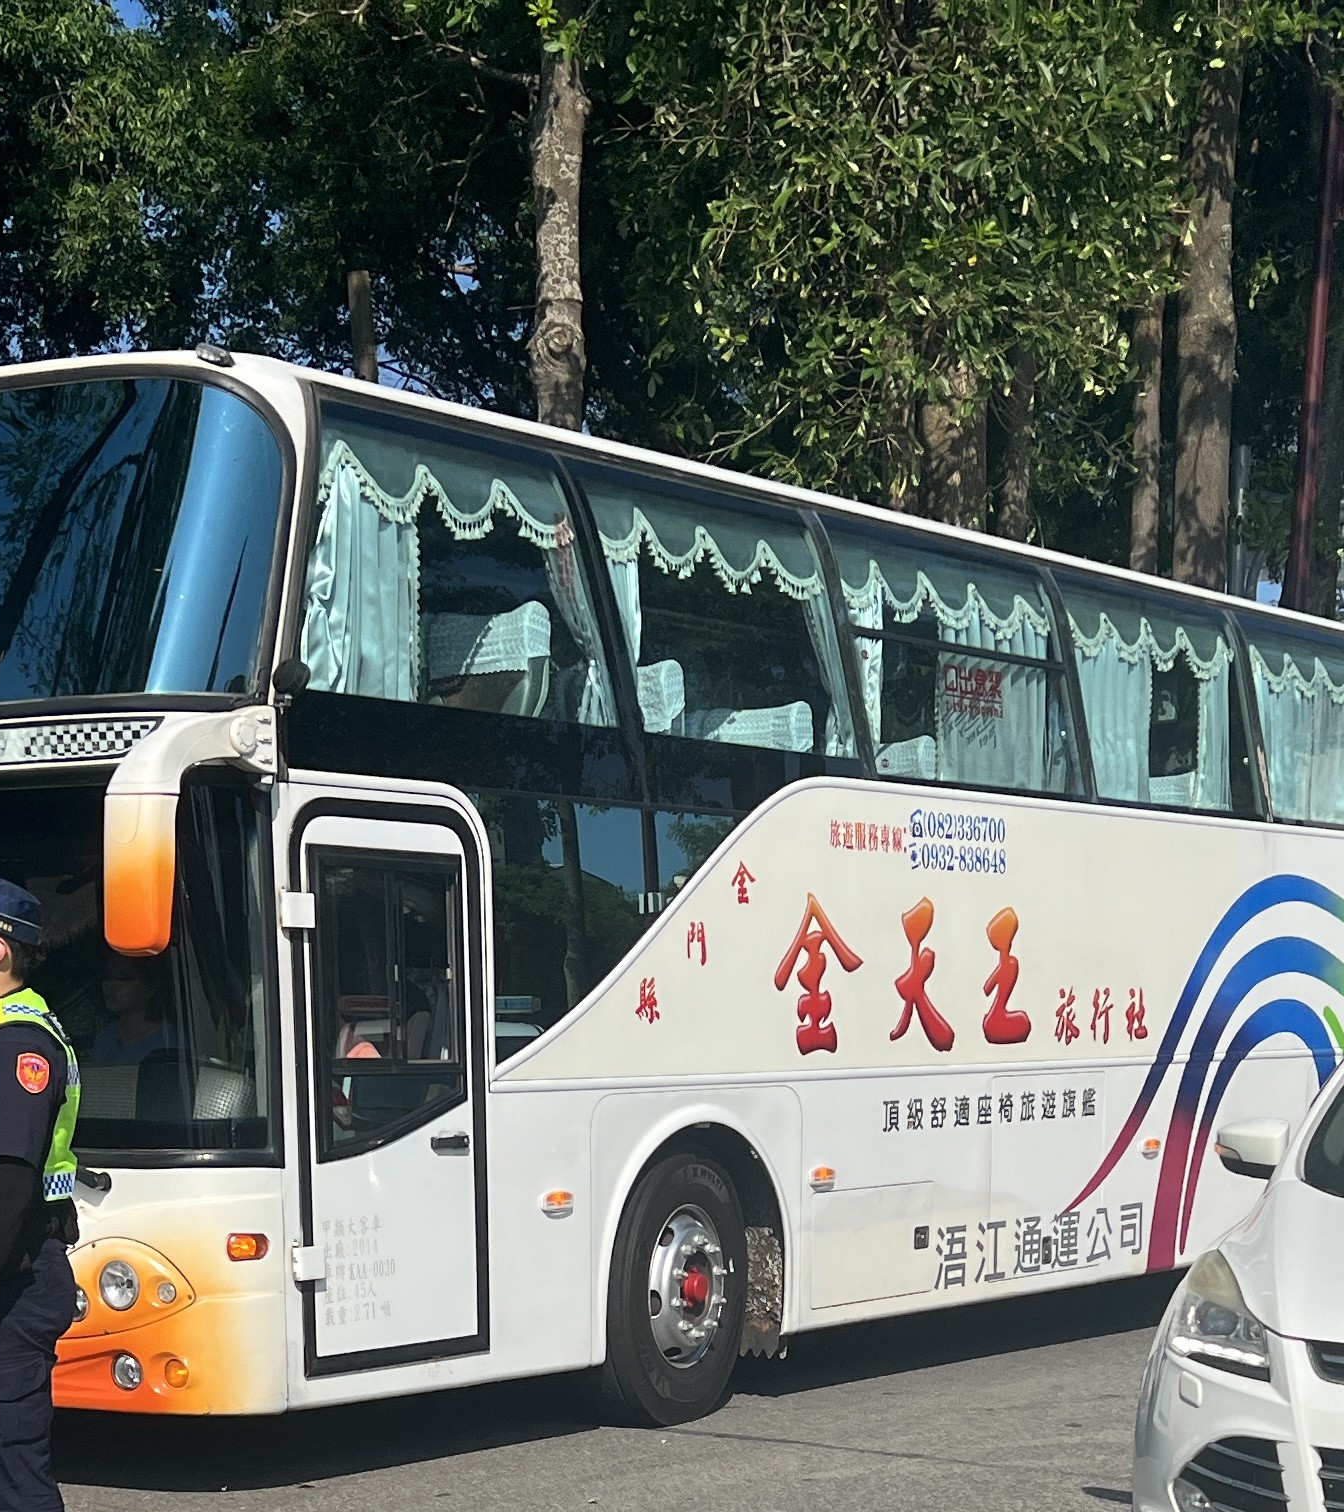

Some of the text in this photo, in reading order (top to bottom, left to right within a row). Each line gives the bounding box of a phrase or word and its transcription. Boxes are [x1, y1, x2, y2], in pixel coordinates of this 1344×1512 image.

[923, 810, 1006, 843] (082)336700
[921, 844, 1006, 874] 0932-838648
[774, 892, 1148, 1056] 金天王 旅行社
[883, 1087, 1097, 1133] 頂級舒適座椅旅遊旗艦
[934, 1202, 1143, 1290] 浯江通運公司
